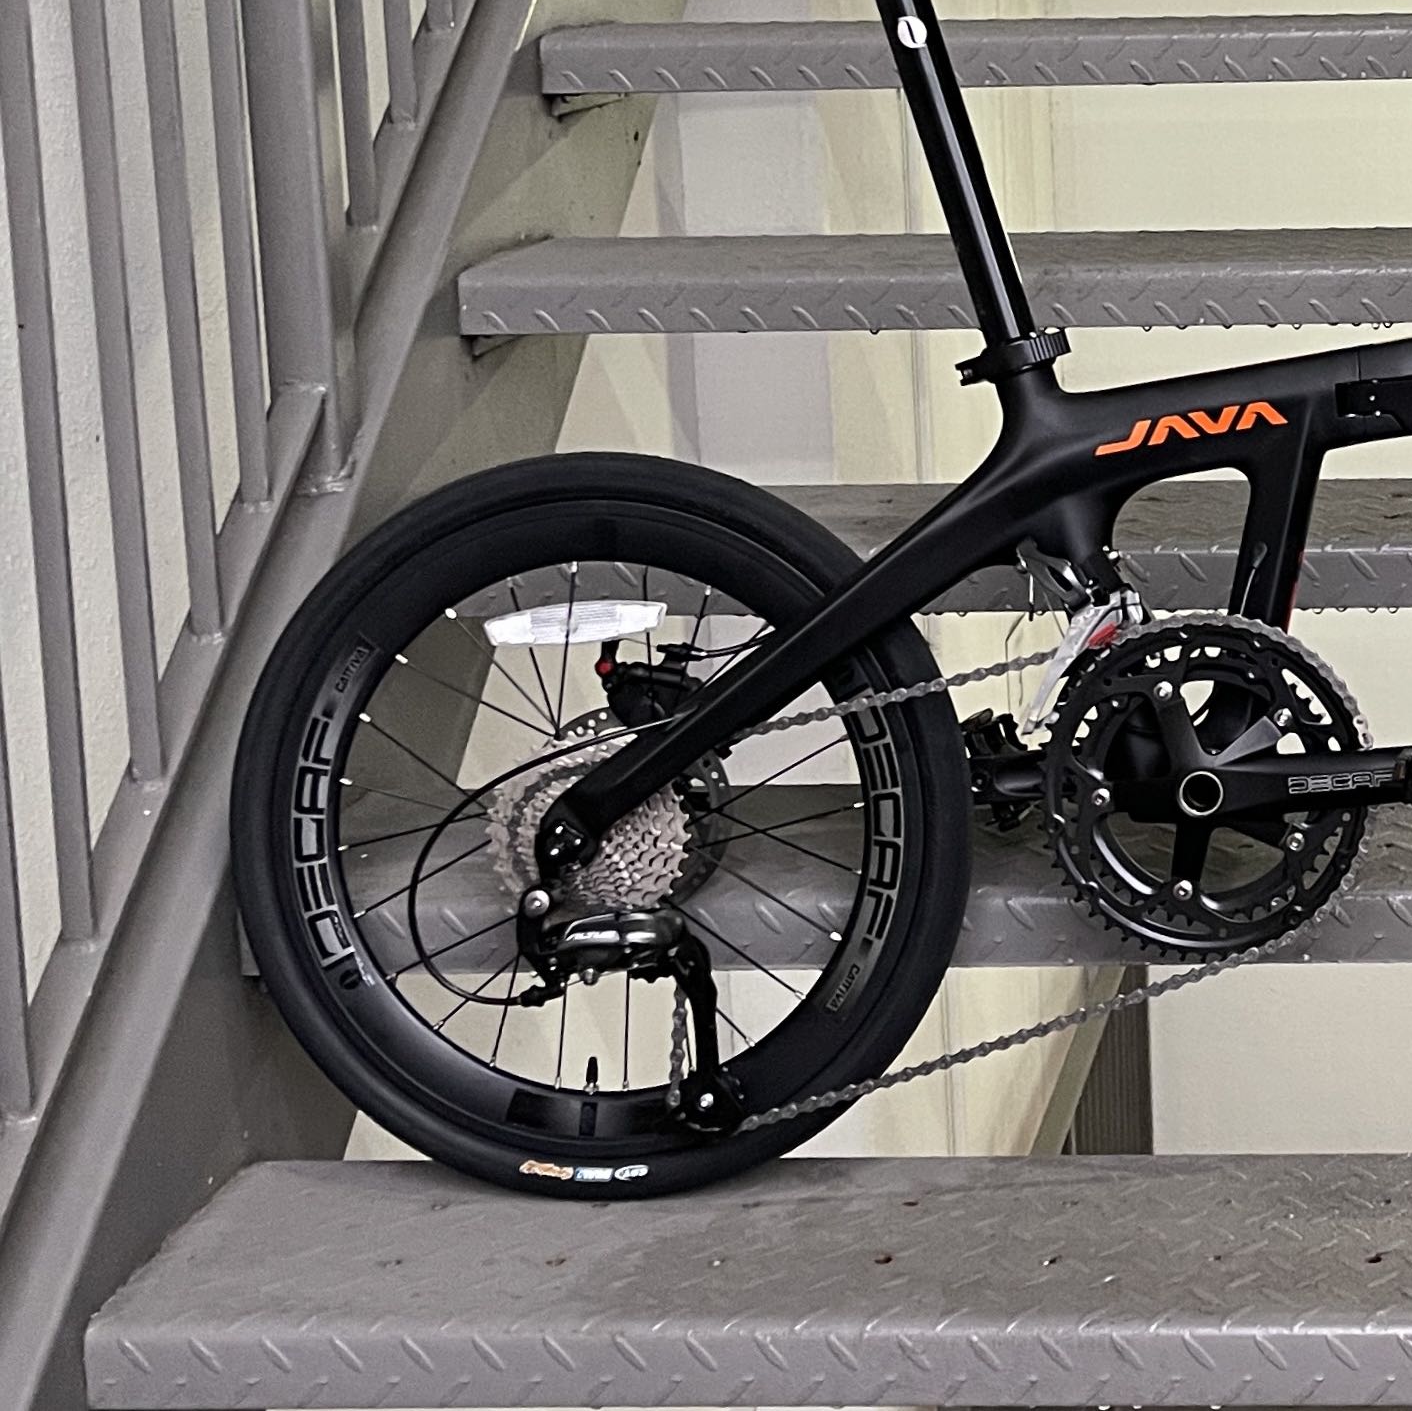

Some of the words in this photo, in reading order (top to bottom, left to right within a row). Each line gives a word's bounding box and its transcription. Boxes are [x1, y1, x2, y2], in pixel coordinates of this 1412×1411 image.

[1095, 401, 1288, 456] JAVA
[1288, 769, 1394, 795] DECAF
[291, 714, 354, 963] DECAF
